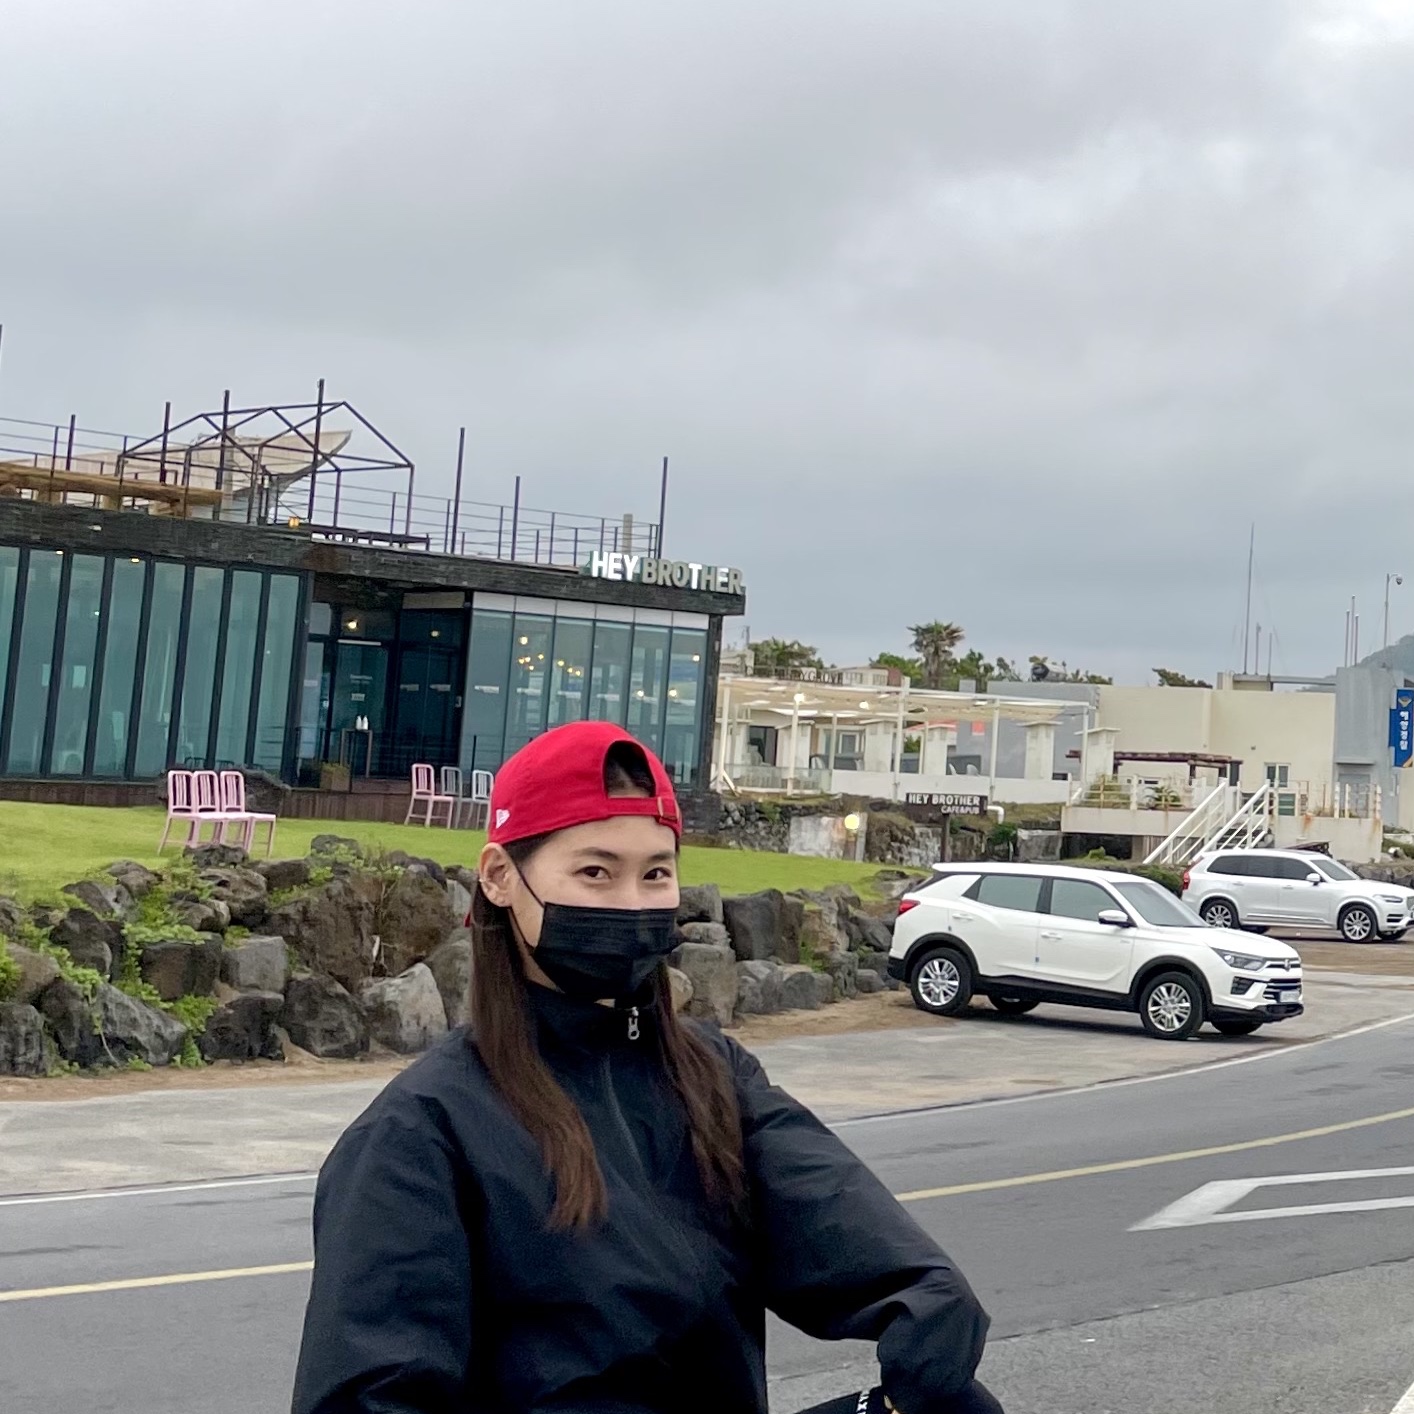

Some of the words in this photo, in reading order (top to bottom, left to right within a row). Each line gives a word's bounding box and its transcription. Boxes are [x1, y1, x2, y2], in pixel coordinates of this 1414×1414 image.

[591, 550, 639, 582] HEY
[642, 557, 743, 595] BROTHER
[908, 793, 929, 804] HEY
[932, 794, 980, 806] BROTHER
